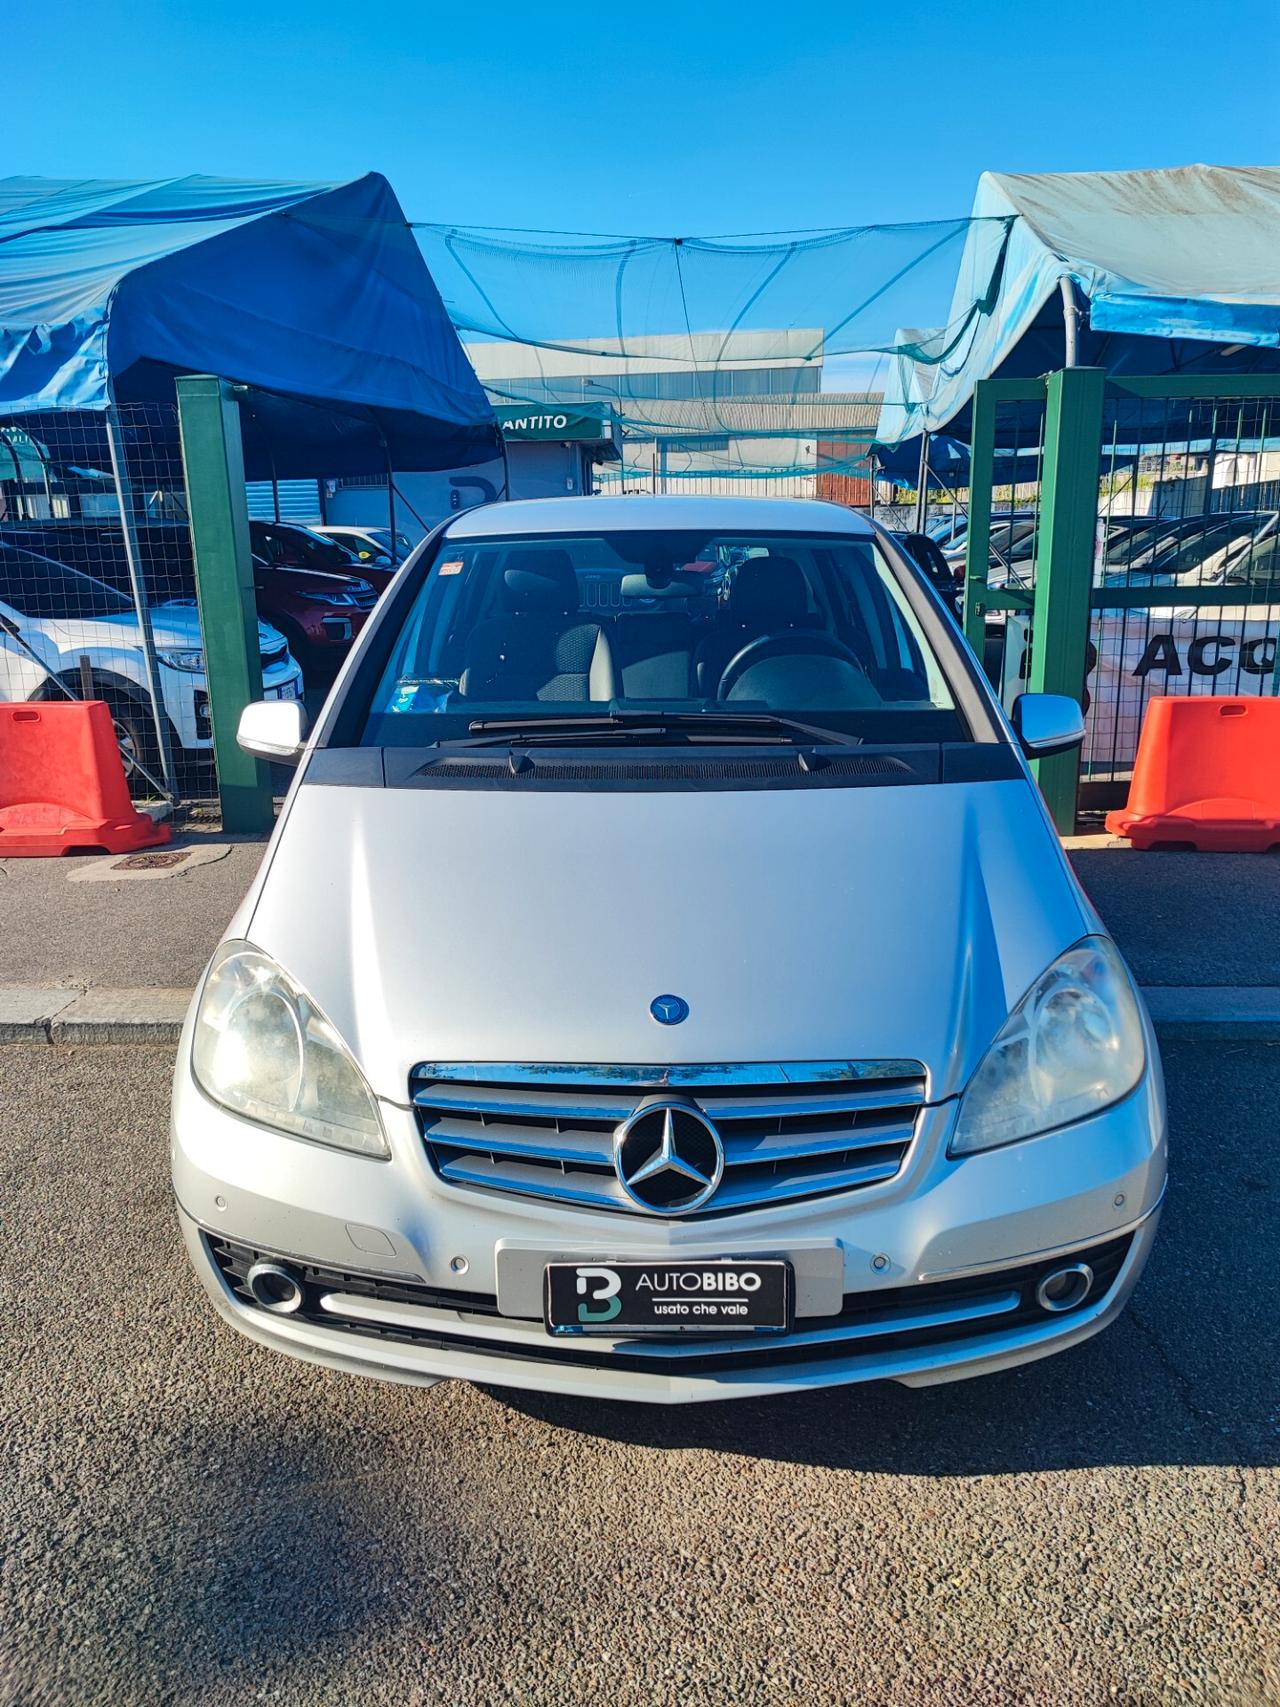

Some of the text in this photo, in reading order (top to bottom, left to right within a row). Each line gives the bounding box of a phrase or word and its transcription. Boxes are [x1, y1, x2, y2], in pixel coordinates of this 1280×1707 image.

[635, 1272, 762, 1291] AUTOBIBO
[654, 1303, 748, 1315] usato che vale
